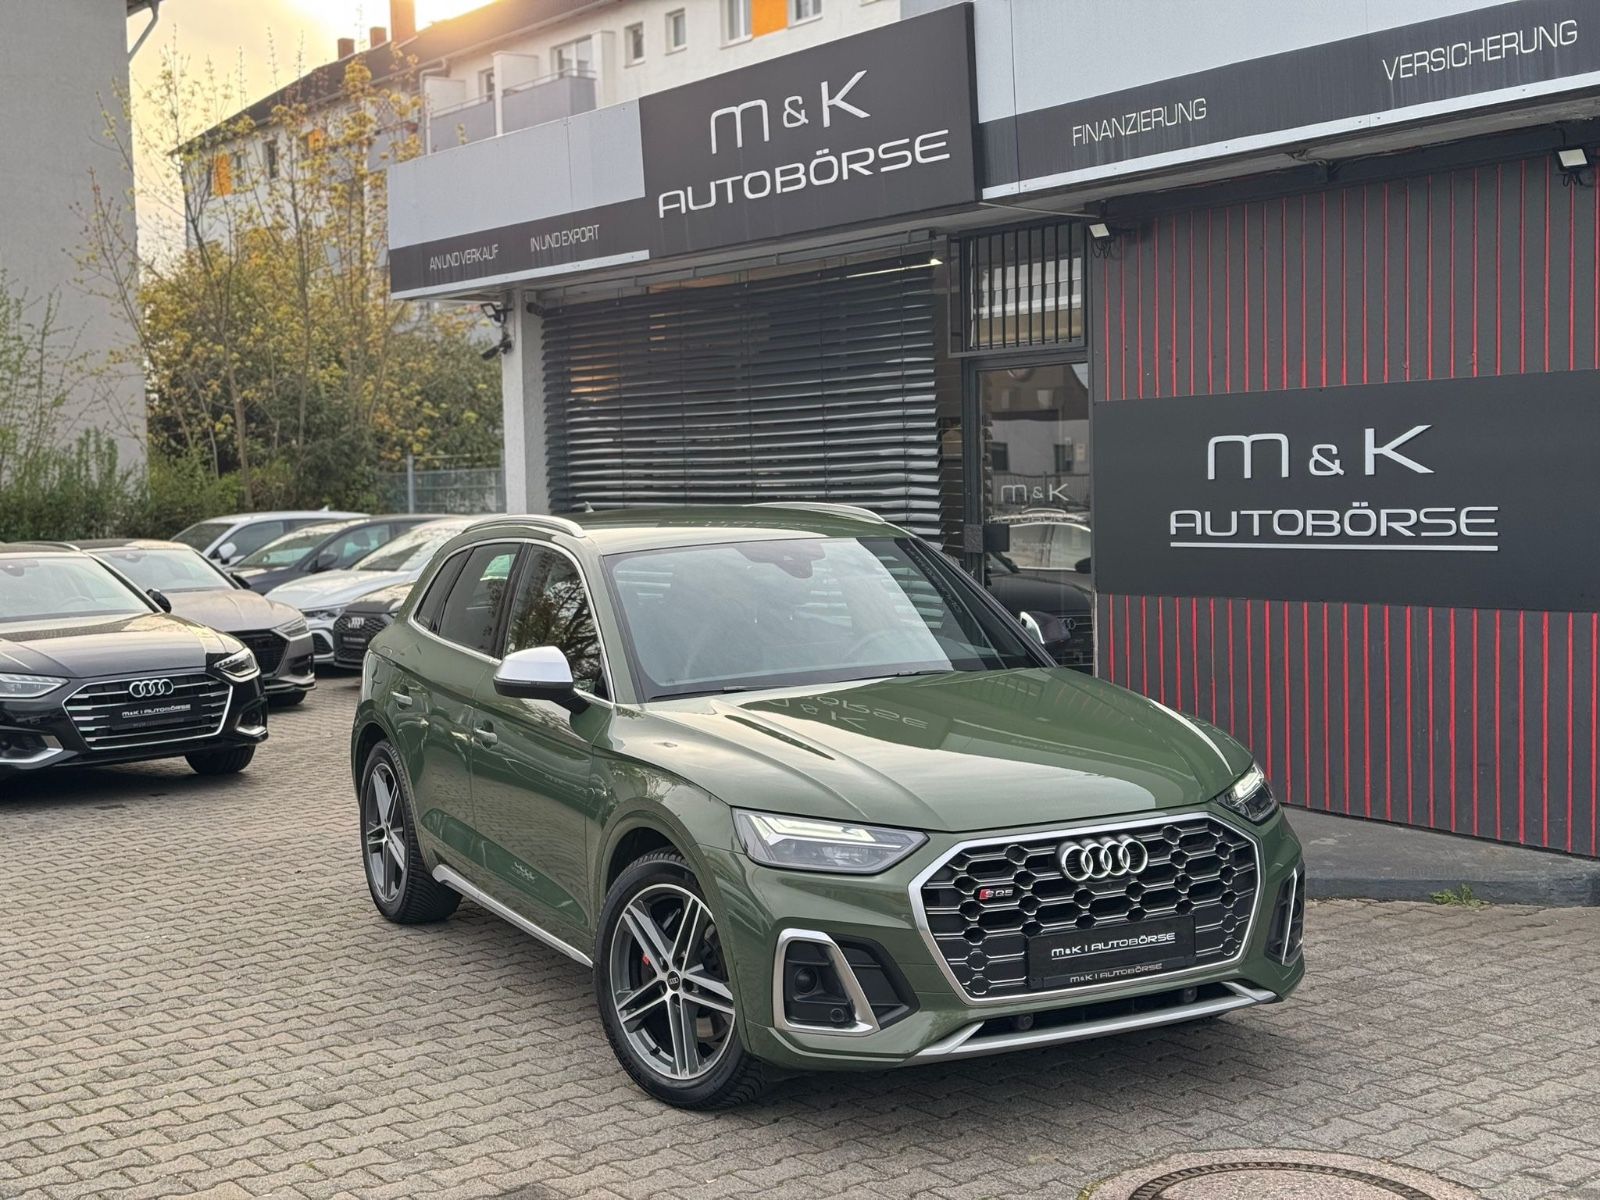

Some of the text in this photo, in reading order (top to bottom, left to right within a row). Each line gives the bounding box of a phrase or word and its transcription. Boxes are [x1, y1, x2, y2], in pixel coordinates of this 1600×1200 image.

[1382, 19, 1578, 81] VERSICHERUNG
[710, 70, 871, 155] M & K
[1072, 97, 1207, 147] FINANZIERUNG
[658, 129, 951, 219] AUTOBÖRSE
[1207, 424, 1436, 481] M & K
[1032, 486, 1044, 499] &
[1049, 483, 1070, 502] K
[1169, 501, 1499, 538] AUTOBÖRSE
[1091, 932, 1176, 951] AUTOBÖRSE
[1099, 963, 1163, 978] AUTOBÖRSE
